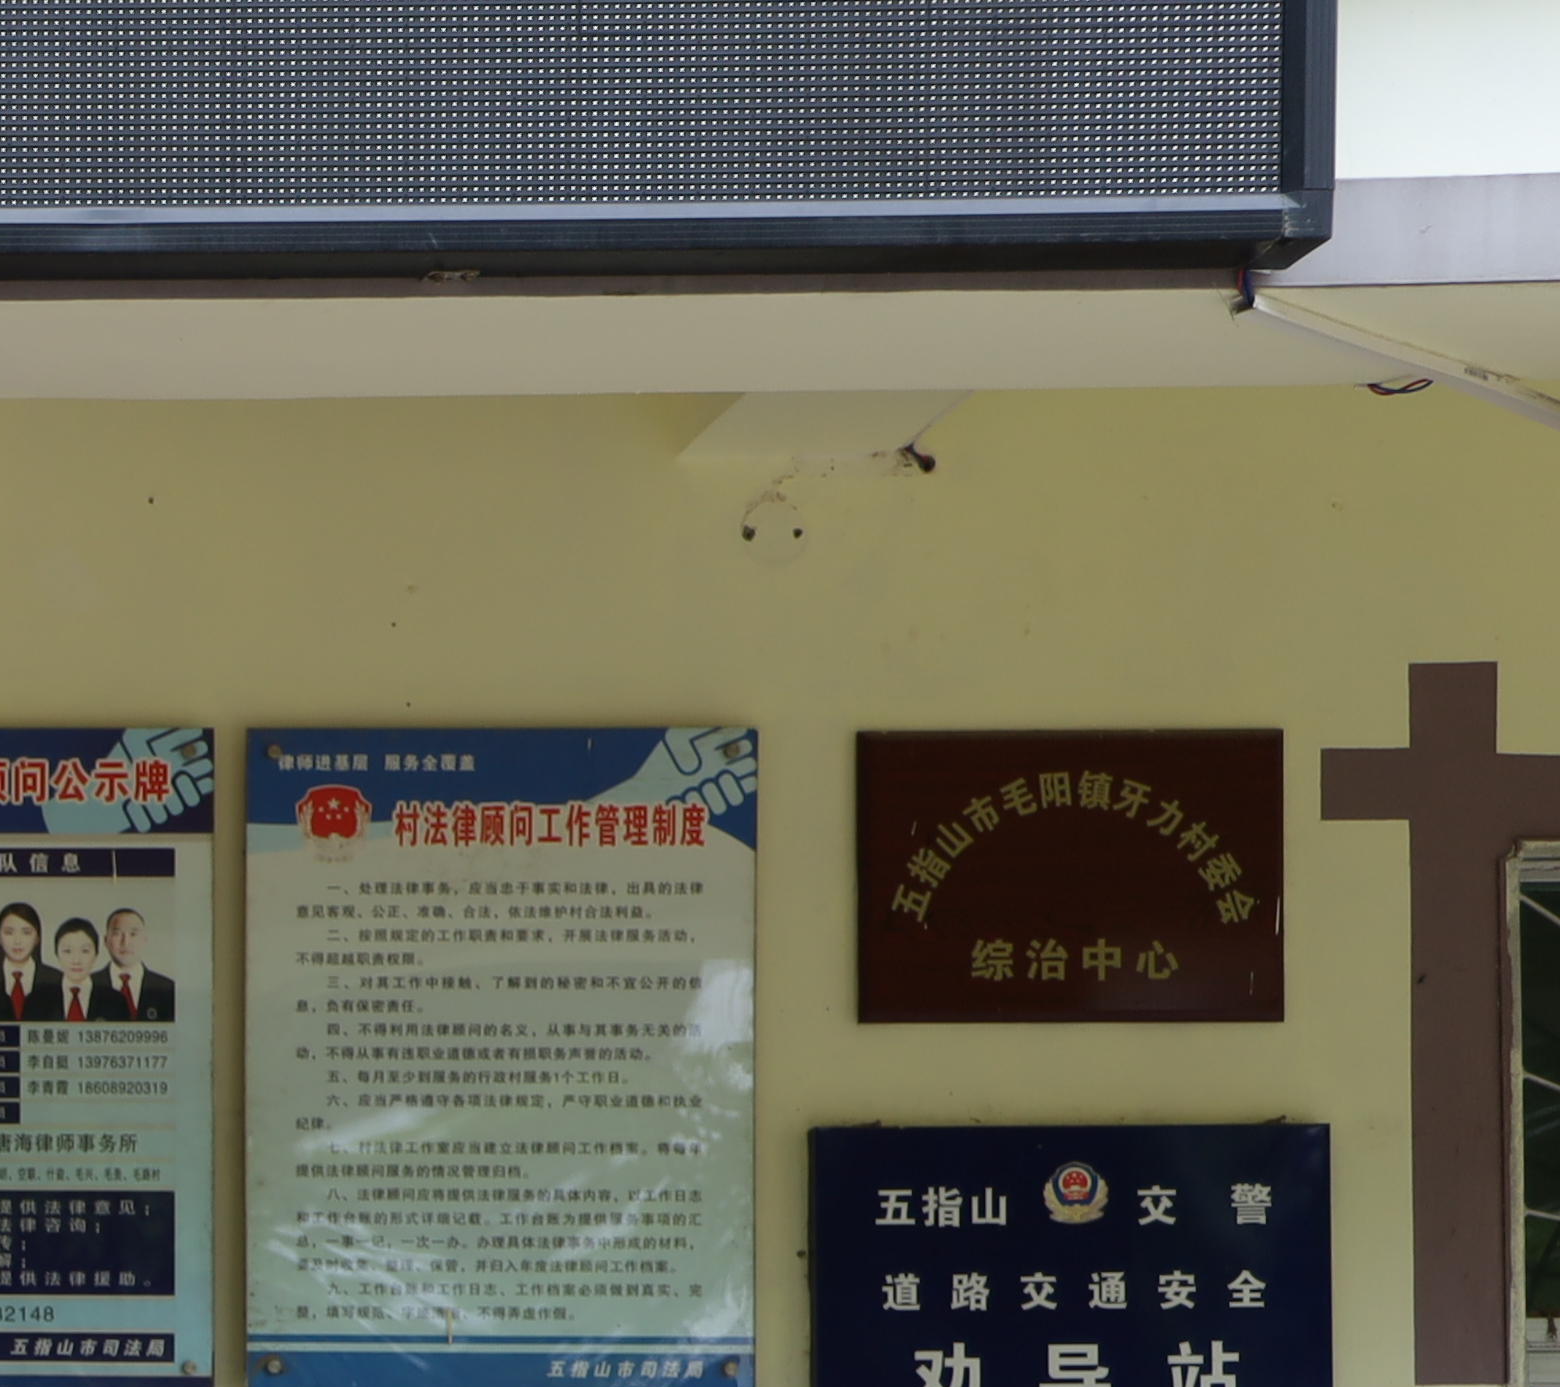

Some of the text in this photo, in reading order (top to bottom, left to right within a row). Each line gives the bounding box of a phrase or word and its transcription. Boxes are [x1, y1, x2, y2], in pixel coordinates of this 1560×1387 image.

[278, 755, 476, 772] 律师进基层 服务全覆盖
[395, 804, 707, 847] 村法律顾问工作管理制度
[892, 770, 1256, 924] 五指山市毛阳镇牙力村委会
[971, 939, 1179, 982] 综治中心
[77, 1030, 168, 1044] 13876209996
[77, 1055, 168, 1069] 13976371177
[77, 1080, 168, 1095] 18608920319
[876, 1187, 1009, 1227] 五指山
[882, 1270, 1267, 1311] 道路交通安全
[11, 1338, 165, 1357] 五指山市司法局
[547, 1361, 704, 1379] 五指山市司法局
